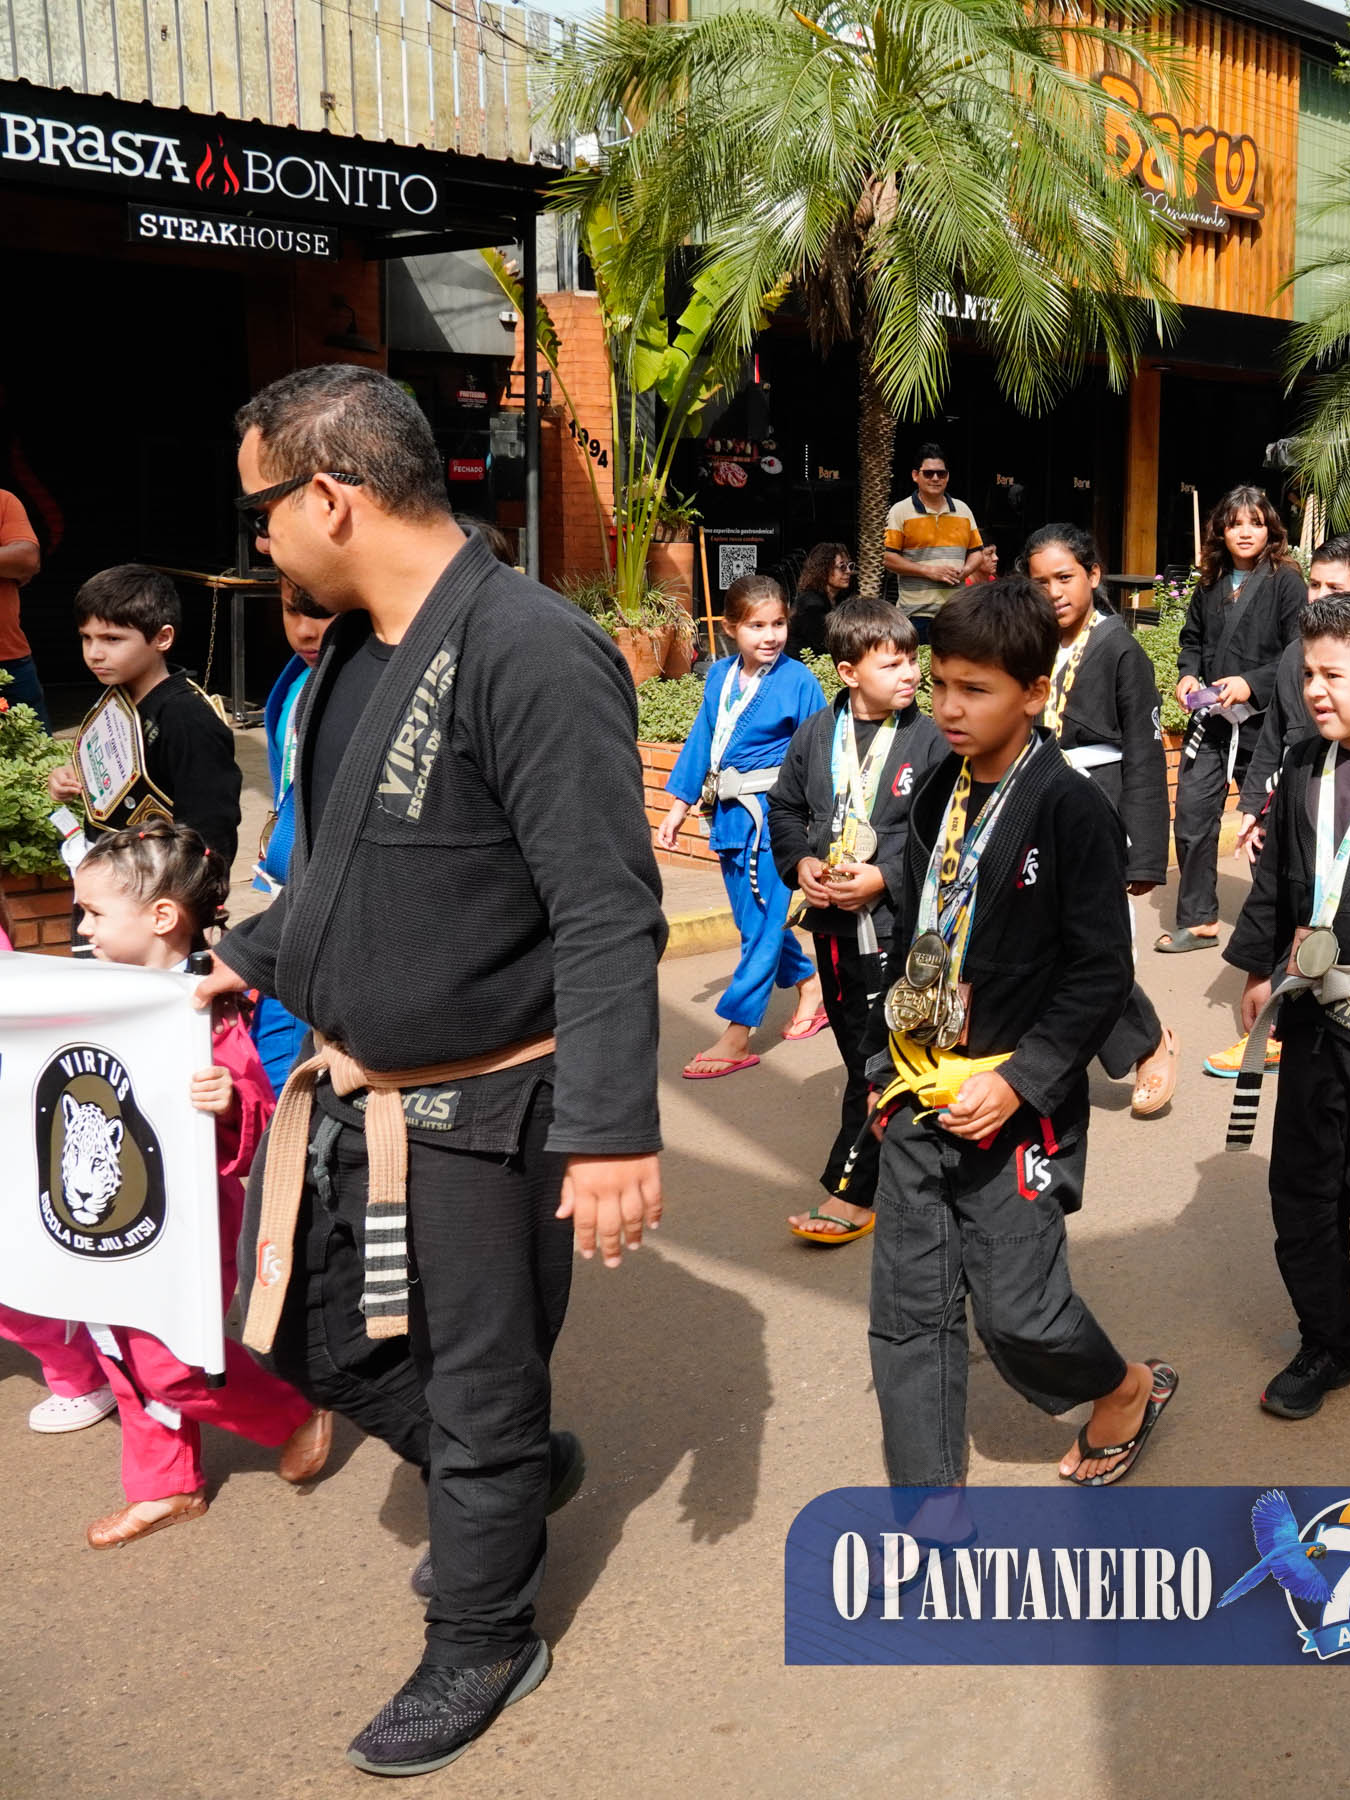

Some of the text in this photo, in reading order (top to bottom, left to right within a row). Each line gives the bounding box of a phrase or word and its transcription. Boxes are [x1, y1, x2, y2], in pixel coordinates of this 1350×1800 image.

[243, 149, 437, 216] BONITO
[140, 213, 330, 256] STEAKHOUSE
[569, 419, 608, 468] 1994
[453, 465, 484, 473] FECHADO
[406, 754, 436, 820] ESCOLA
[59, 1050, 130, 1102] VIRTUS
[421, 1120, 453, 1130] JITSU
[40, 1190, 157, 1252] ESCOLA DE JIU JITSU
